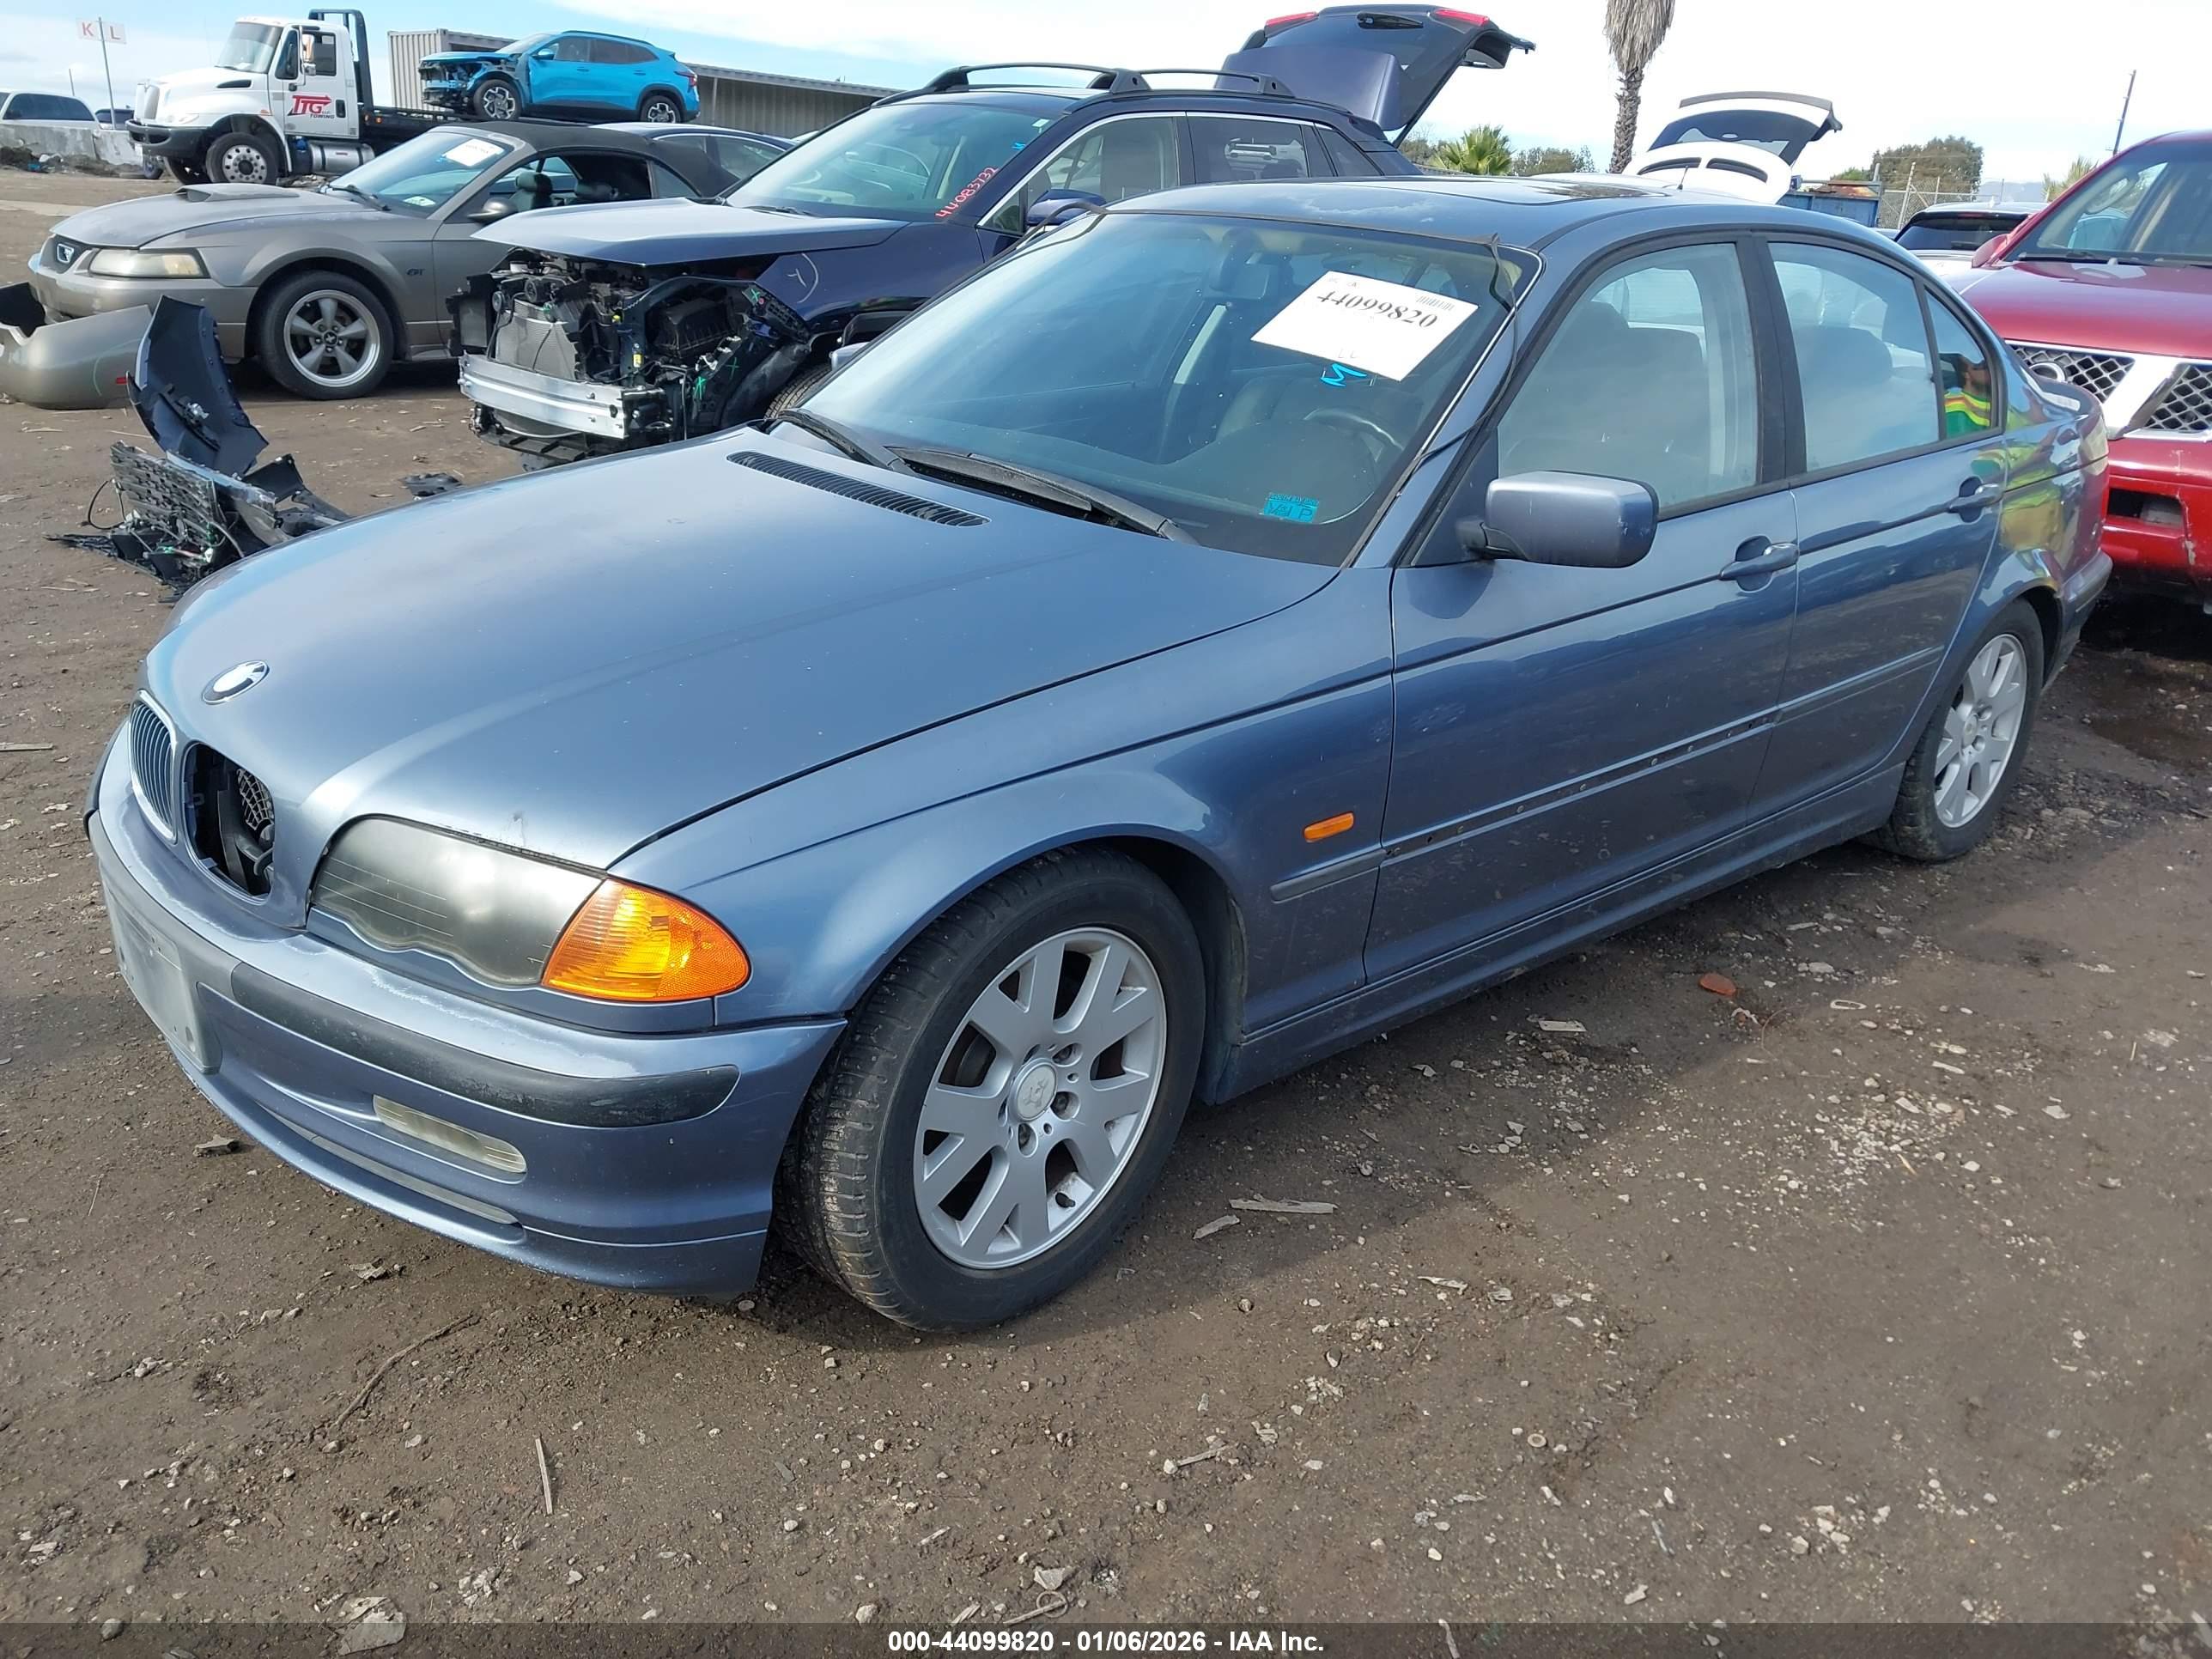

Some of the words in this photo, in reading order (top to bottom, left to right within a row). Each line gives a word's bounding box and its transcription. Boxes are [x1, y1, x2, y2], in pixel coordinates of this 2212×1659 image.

[82, 21, 94, 36] K
[110, 25, 121, 40] L
[292, 94, 331, 114] TTG
[1316, 289, 1438, 329] 44099820
